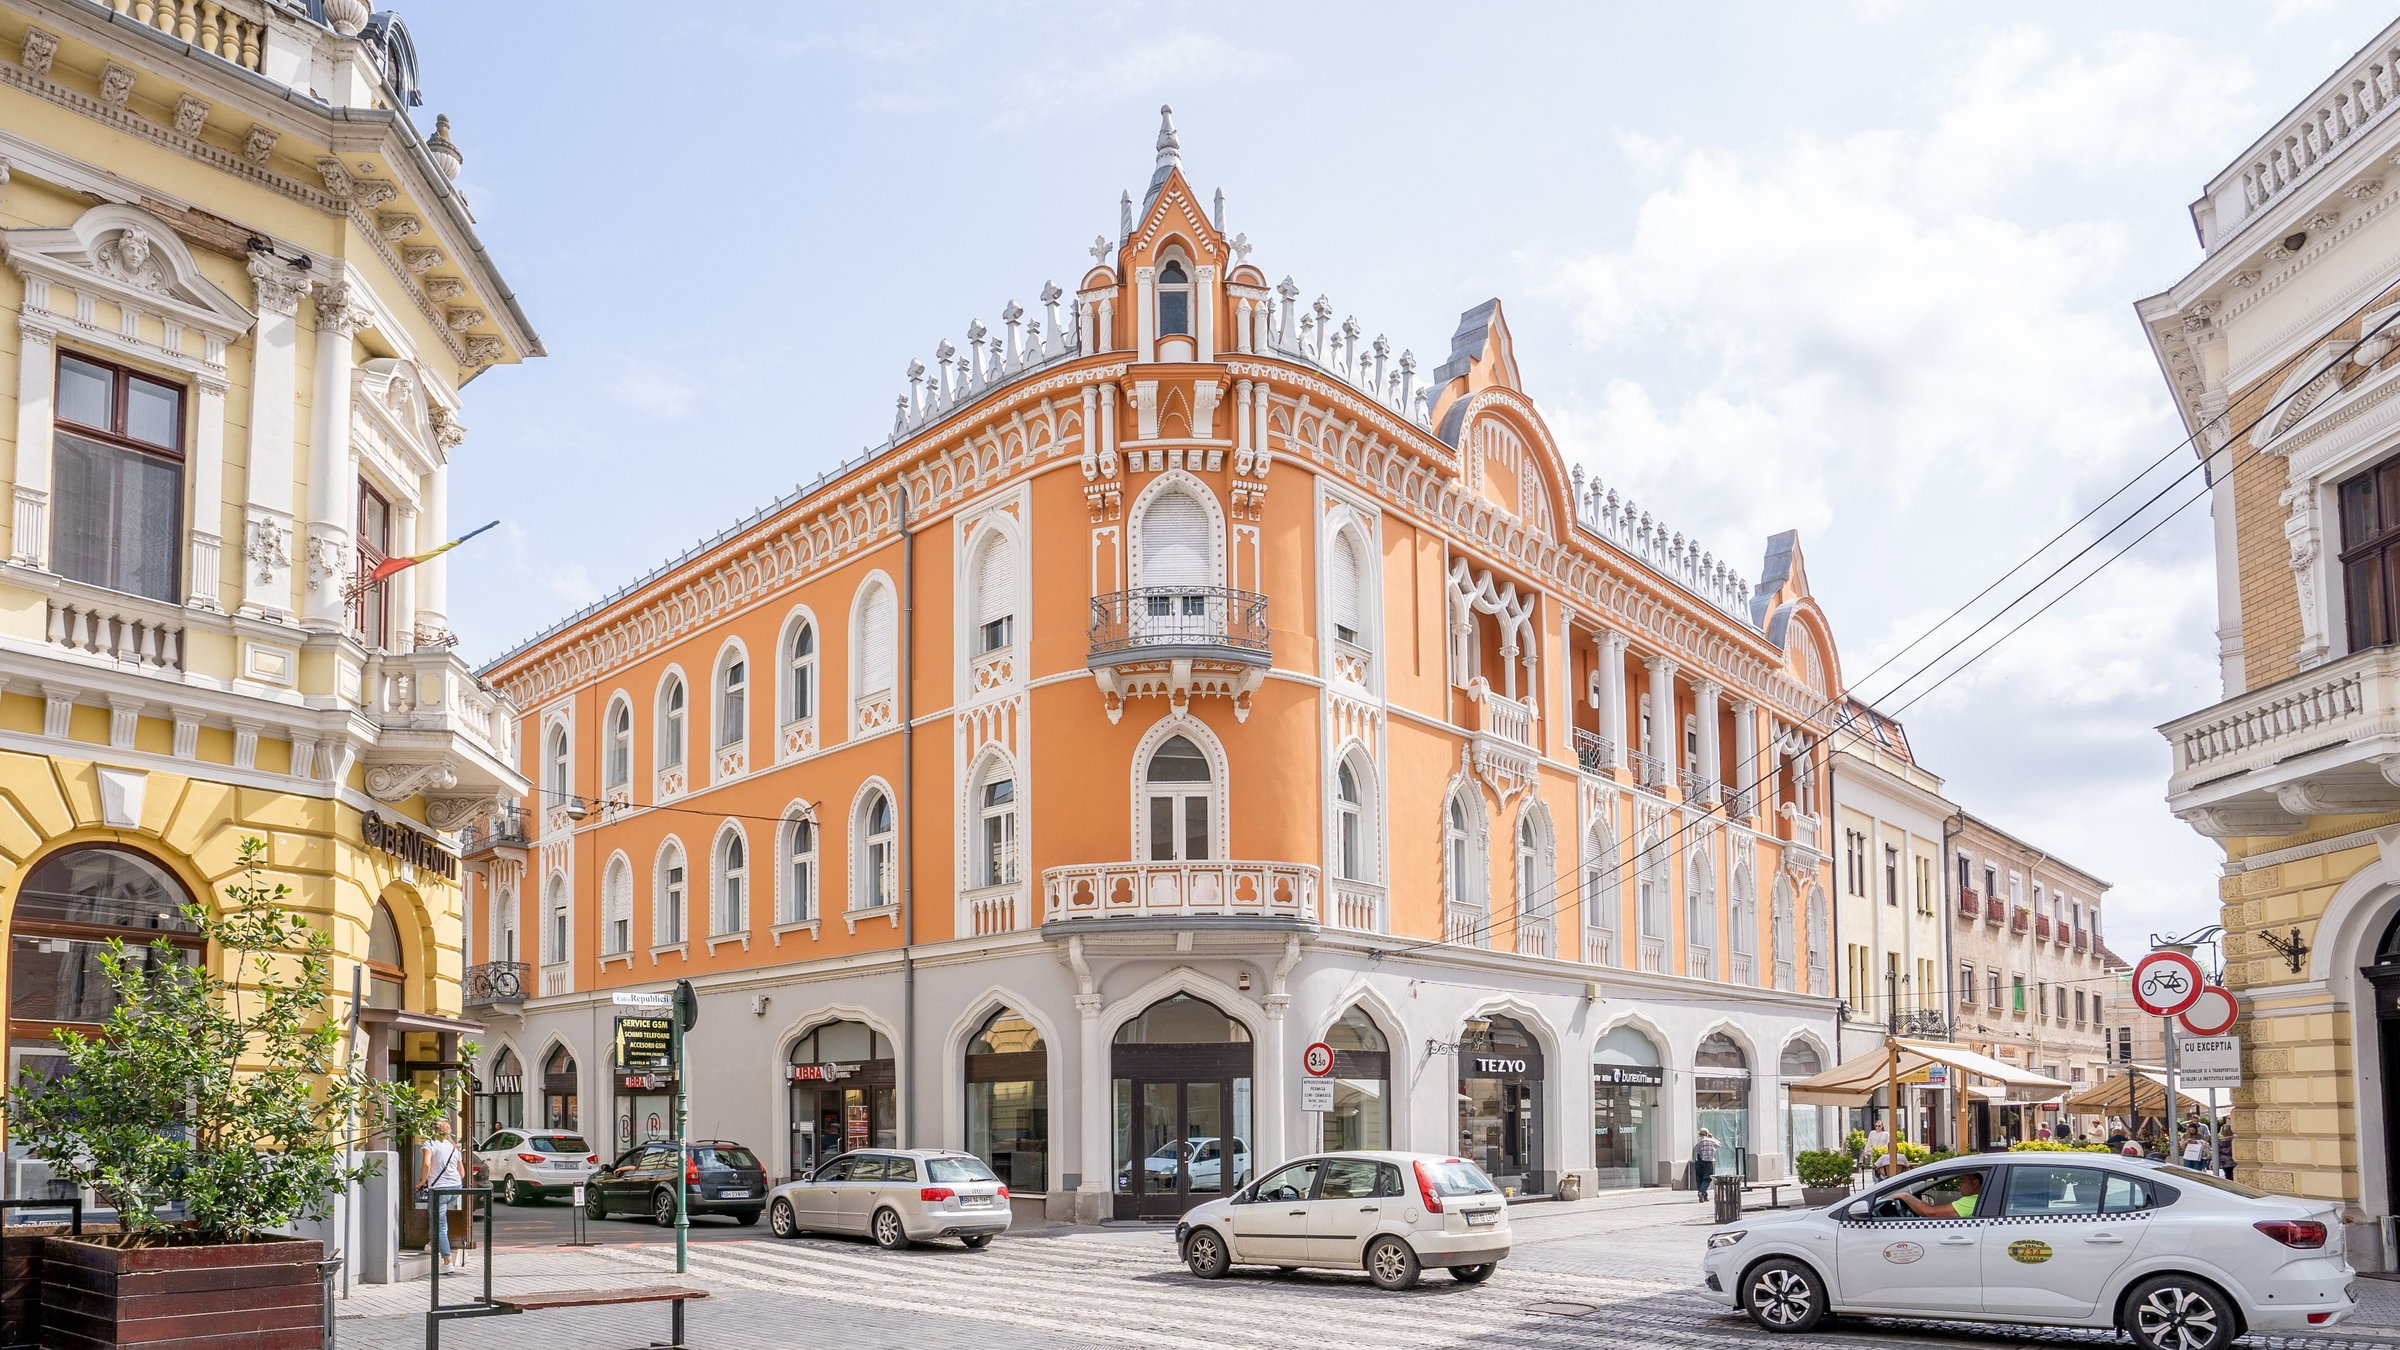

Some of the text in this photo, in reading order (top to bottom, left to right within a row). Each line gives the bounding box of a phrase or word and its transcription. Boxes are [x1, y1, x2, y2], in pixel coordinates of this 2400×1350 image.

[631, 994, 669, 1004] Republicii
[622, 1019, 668, 1029] SERVICE GSM
[2185, 1041, 2232, 1052] CU EXCEPTIA
[1480, 1058, 1526, 1074] TEZYO
[793, 1066, 823, 1080] LIBRA
[624, 1077, 645, 1088] LIBRA
